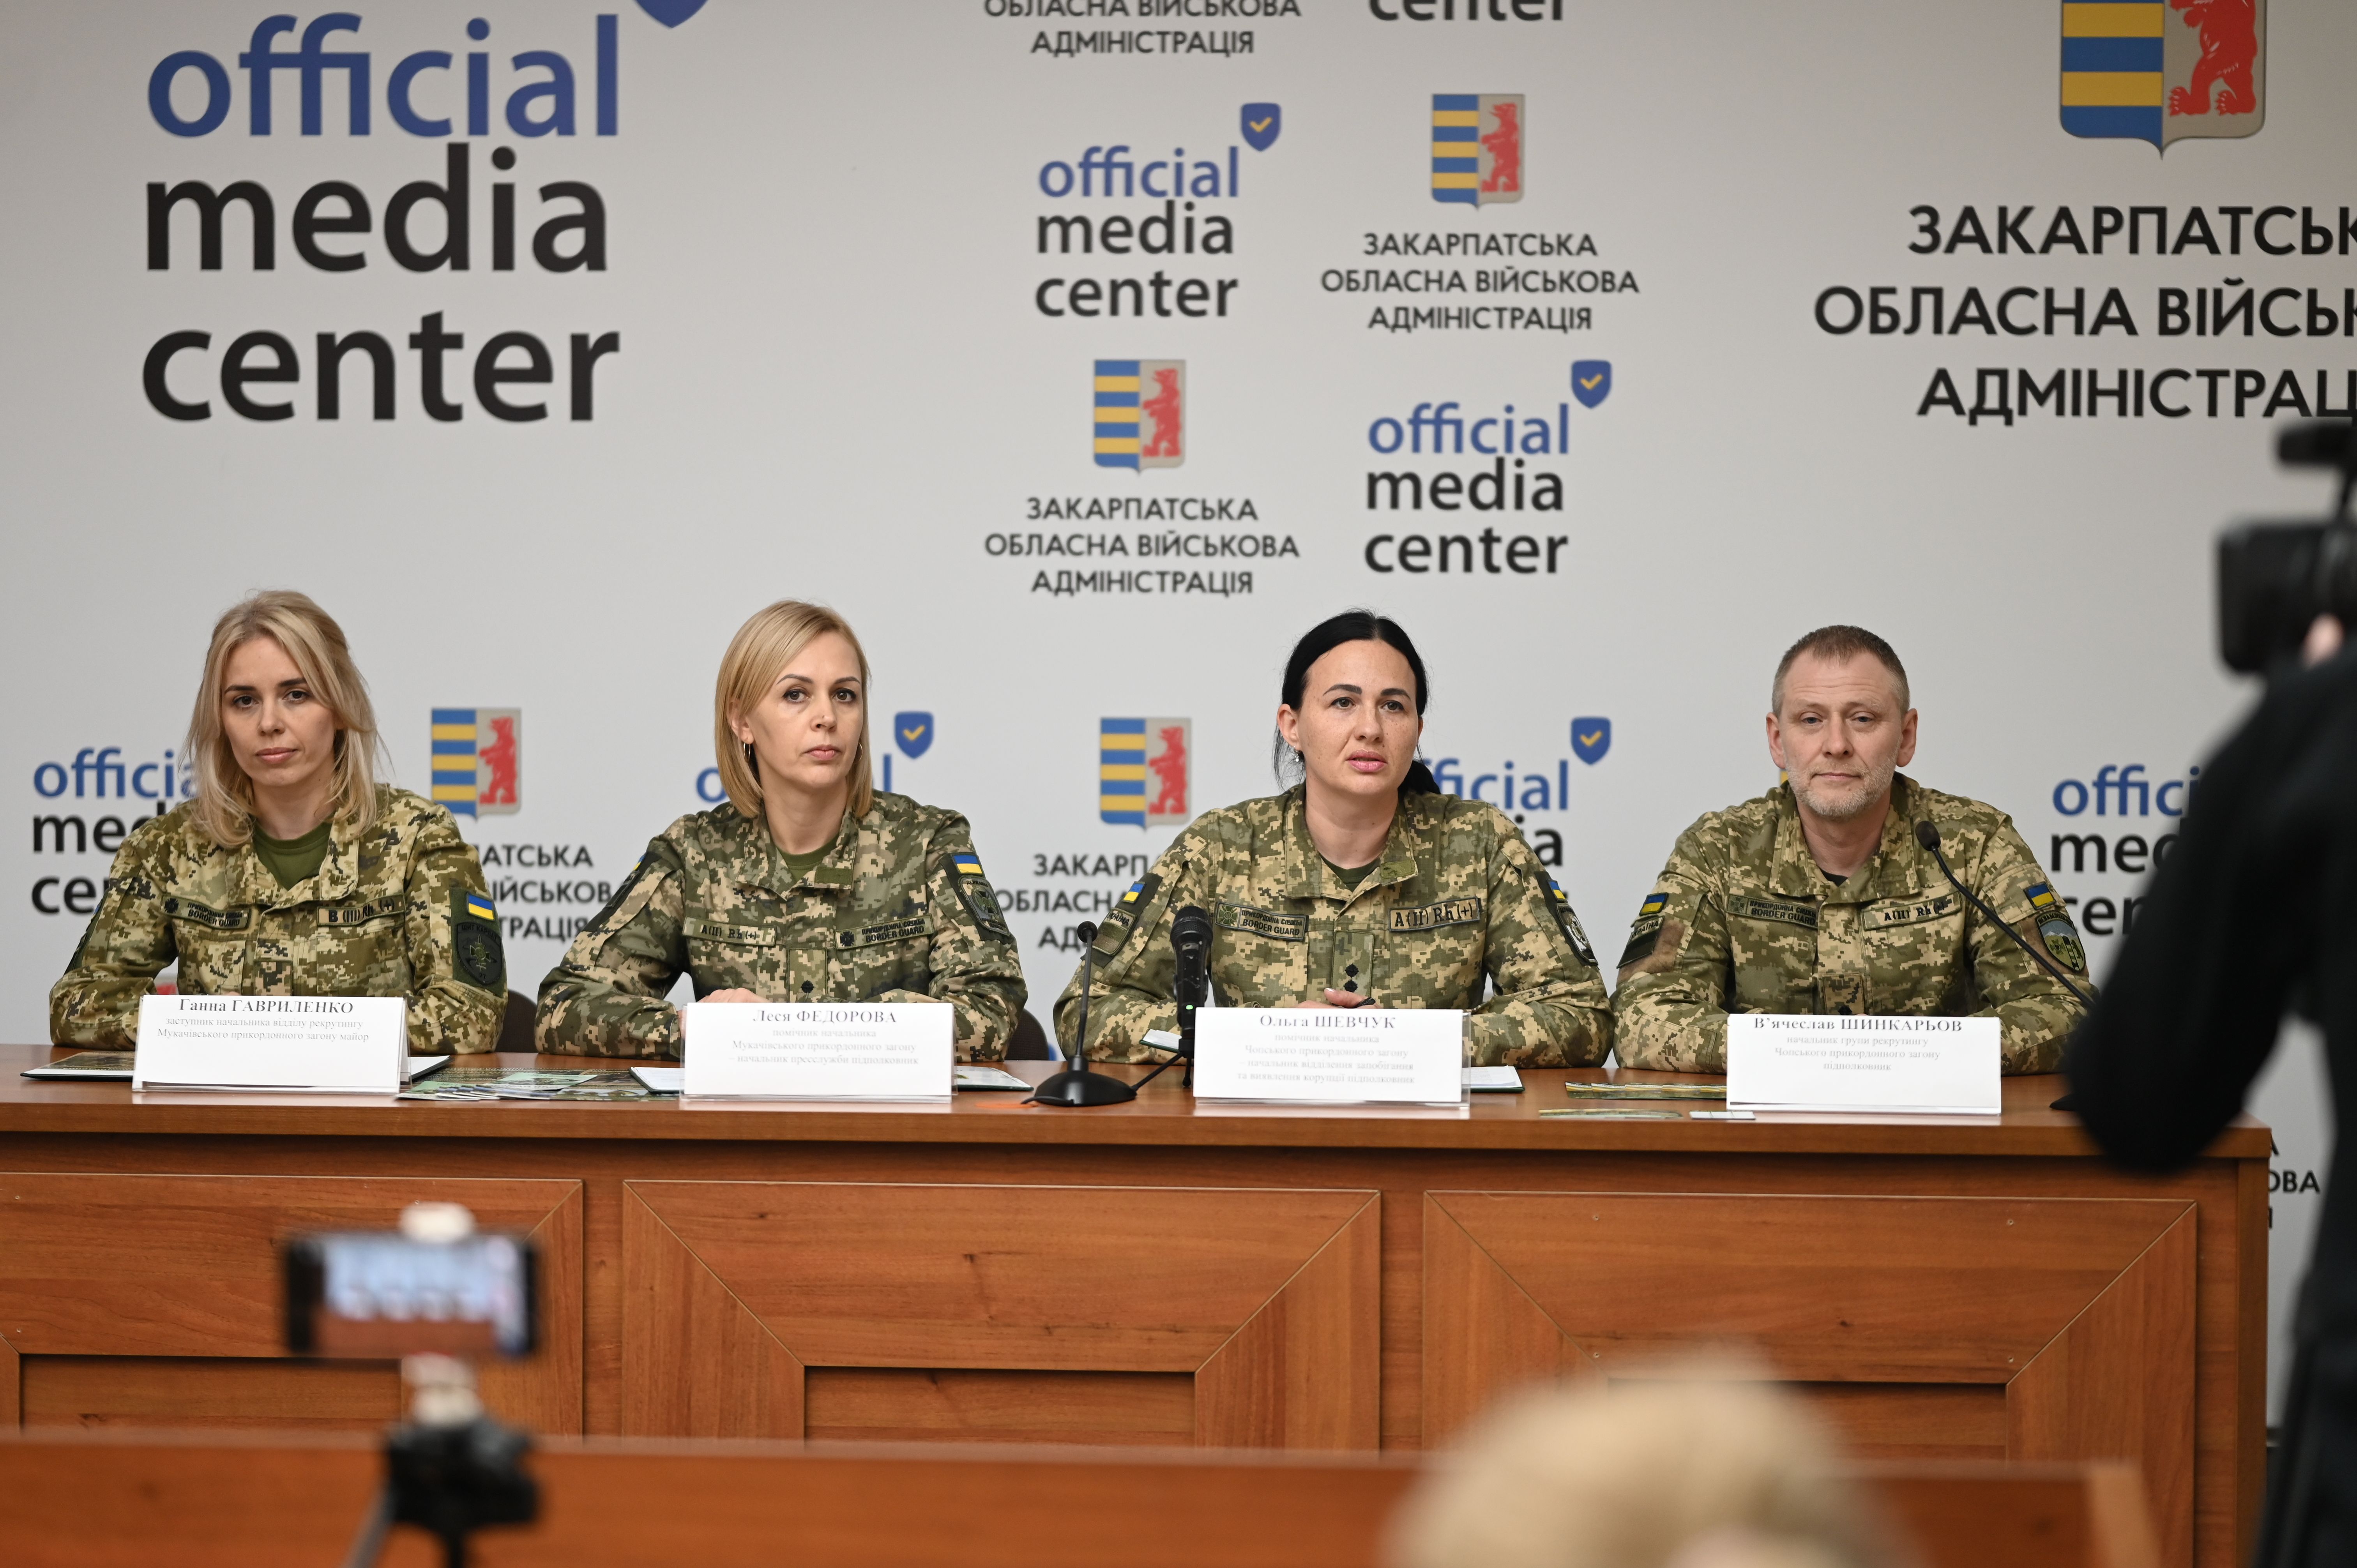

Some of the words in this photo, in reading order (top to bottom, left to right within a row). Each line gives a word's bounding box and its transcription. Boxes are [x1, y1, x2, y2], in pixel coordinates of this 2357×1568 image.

[984, 0, 1129, 17] ОБЛАСНА
[1031, 31, 1254, 57] АДМІНІСТРАЦІЯ
[148, 12, 618, 138] official
[1039, 145, 1239, 198] official
[146, 142, 607, 273] media
[1038, 200, 1233, 254] media
[1364, 233, 1597, 256] ЗАКАРПАТСЬКА
[1321, 270, 1467, 293] ОБЛАСНА
[1476, 266, 1640, 293] ВІЙСЬКОВА
[1035, 271, 1238, 317] center
[1815, 286, 2139, 336] ОБЛАСНА
[1368, 307, 1592, 334] АДМІНІСТРАЦІЯ
[142, 311, 620, 423] center
[1368, 402, 1569, 455] official
[1367, 456, 1563, 511] media
[1027, 497, 1258, 521] ЗАКАРПАТСЬКА
[985, 533, 1129, 556] ОБЛАСНА
[1138, 531, 1300, 557] ВІЙСЬКОВА
[1365, 528, 1569, 574] center
[1031, 570, 1253, 597] АДМІНІСТРАЦІЯ
[995, 890, 1125, 912] ОБЛАСН
[1750, 900, 1793, 912] ПРИКОРДОННА
[188, 909, 217, 926] BORDER
[219, 918, 240, 927] GUARD
[1241, 910, 1279, 924] ПРИКОРДОННА
[1751, 908, 1786, 919] BORDER
[1787, 913, 1816, 925] GUARD
[866, 931, 898, 943] BORDER
[898, 925, 925, 936] GUARD
[1242, 919, 1272, 932] BORDER
[1274, 926, 1300, 936] GUARD
[179, 999, 226, 1012] Ганна
[231, 1000, 353, 1014] ГАВРИЛЕНКО
[165, 1019, 214, 1027] заступник
[273, 1019, 307, 1029] відділу
[309, 1020, 363, 1029] рекрутингу
[753, 1010, 790, 1022] Леся
[797, 1010, 897, 1024] ФЕДОРОВА
[1260, 1014, 1309, 1027] Ольга
[1315, 1016, 1396, 1029] ШЕВЧУК
[1841, 1019, 1963, 1032] ШИНКАРЬОВ
[157, 1028, 228, 1039] Мукачівського
[231, 1032, 303, 1040] прикордонного
[306, 1032, 337, 1041] загону
[340, 1032, 369, 1043] майор
[1275, 1033, 1321, 1042] помічник
[1841, 1037, 1869, 1046] групи
[1872, 1038, 1928, 1047] рекрутингу
[732, 1040, 804, 1051] Мукачівського
[807, 1044, 882, 1052] прикордонного
[885, 1044, 916, 1052] загону
[1245, 1045, 1297, 1055] Чопського
[1299, 1047, 1374, 1057] прикордонного
[1378, 1049, 1408, 1058] загону
[1775, 1047, 1827, 1057] Чопського
[1829, 1050, 1905, 1059] прикордонного
[1909, 1051, 1940, 1060] загону
[1823, 1061, 1891, 1071] підполковник
